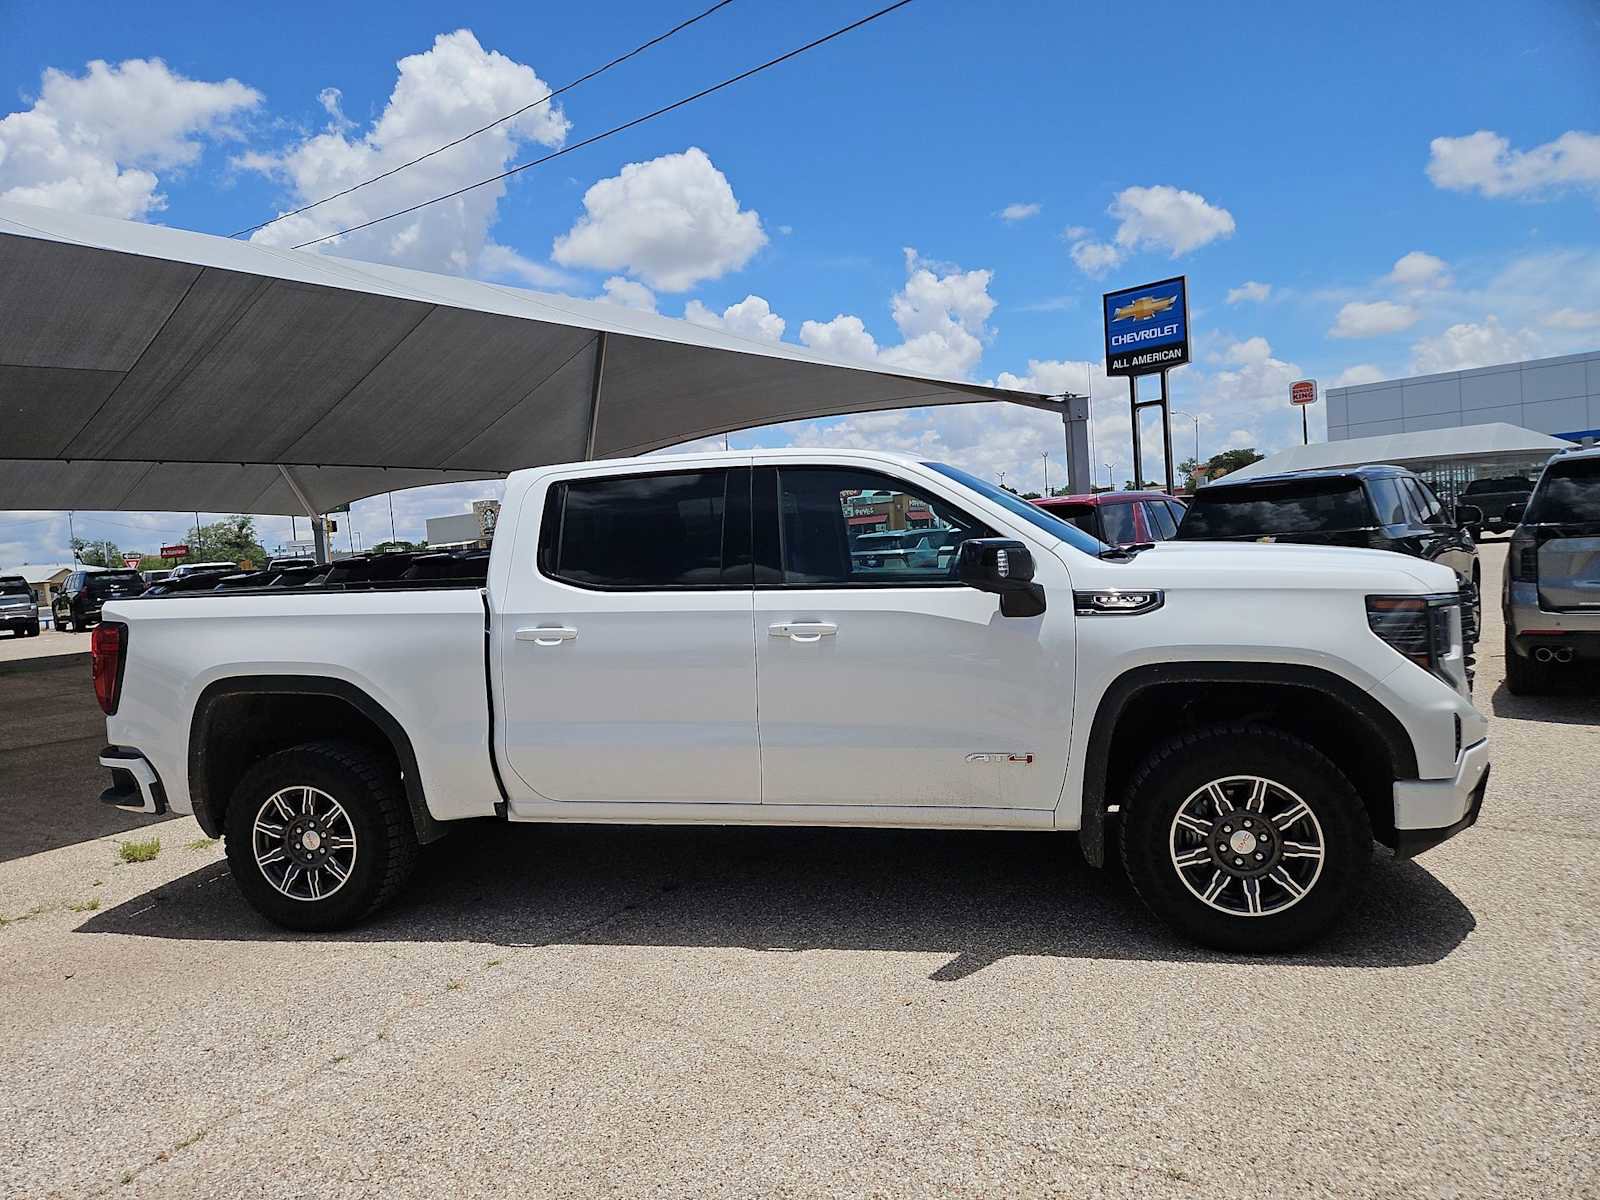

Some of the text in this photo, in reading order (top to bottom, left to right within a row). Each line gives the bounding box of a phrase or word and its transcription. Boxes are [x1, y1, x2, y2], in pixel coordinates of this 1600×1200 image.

[1111, 323, 1179, 346] CHEVROLET
[1112, 348, 1182, 370] ALL AMERICAN
[1292, 391, 1314, 400] KING
[965, 752, 1033, 764] AT4
